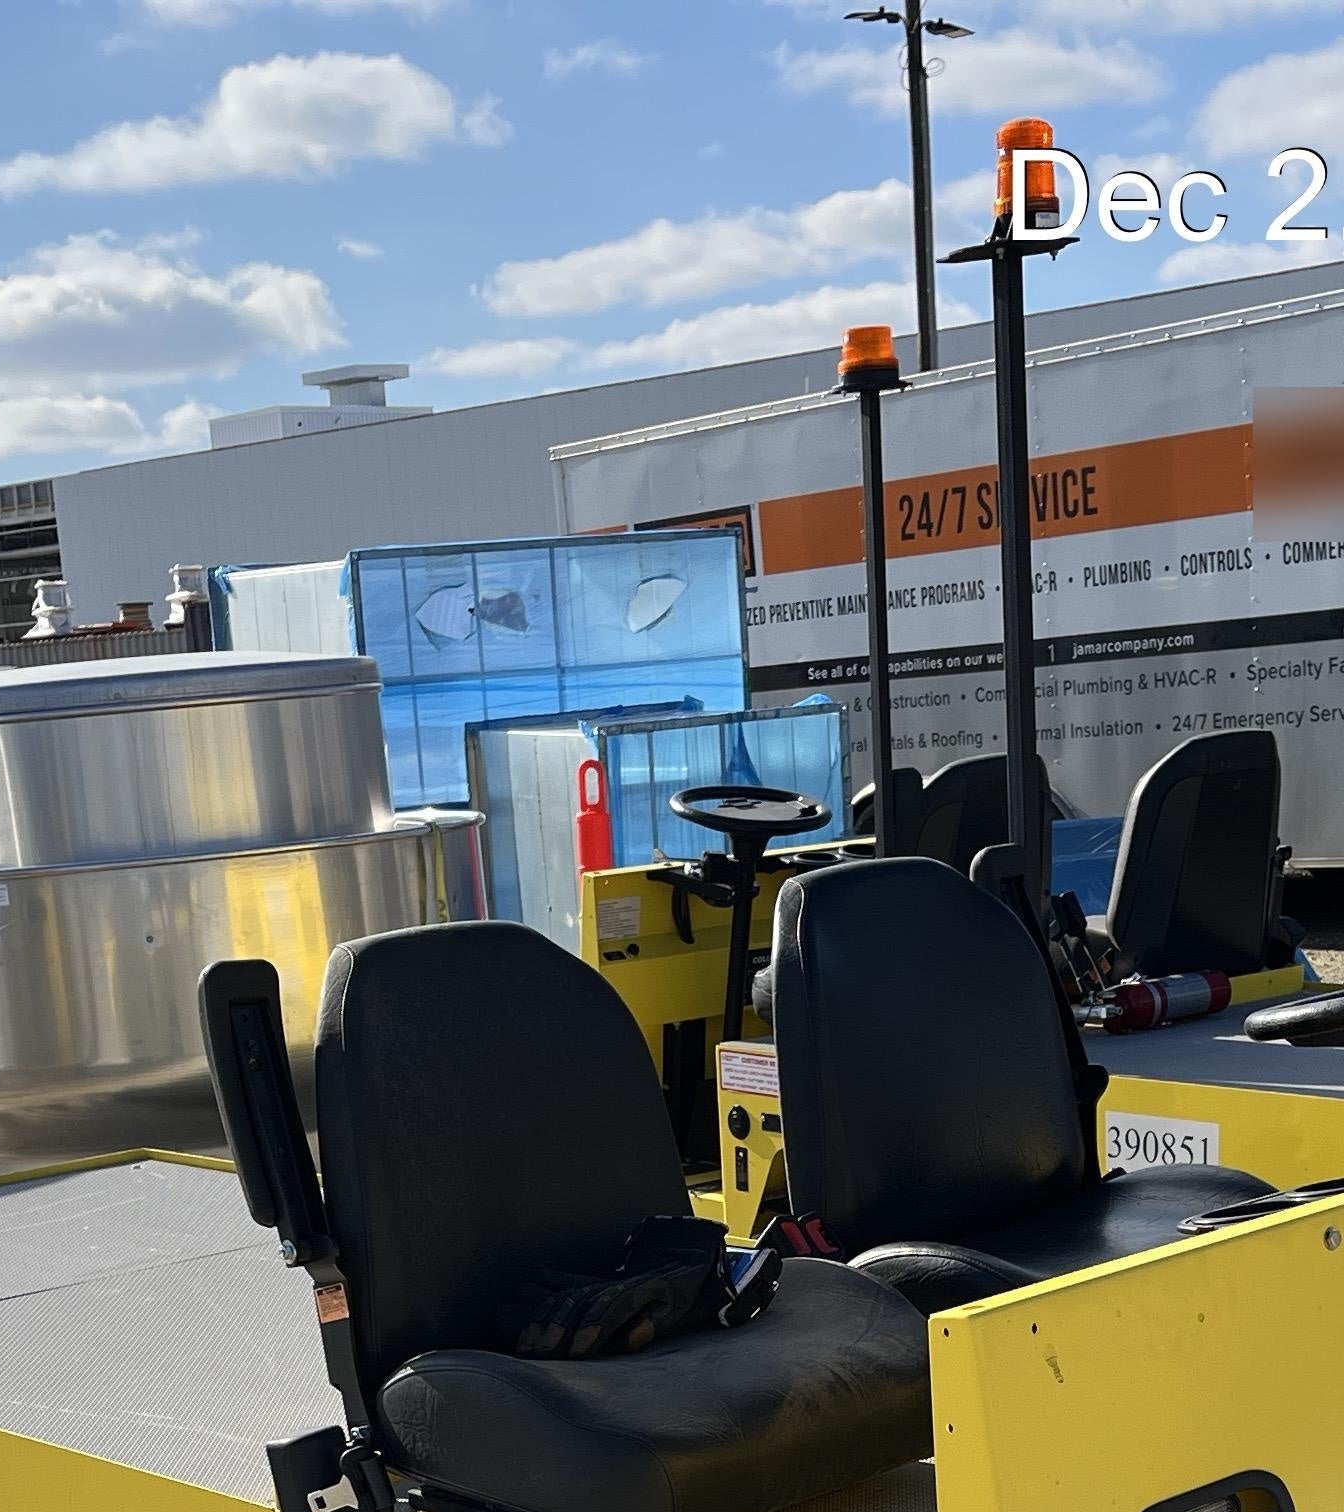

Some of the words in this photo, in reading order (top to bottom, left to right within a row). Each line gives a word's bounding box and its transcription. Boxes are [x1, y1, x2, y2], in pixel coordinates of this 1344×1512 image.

[899, 486, 966, 543] 24/7
[977, 466, 1098, 531] SVICE
[747, 606, 766, 627] ZED
[769, 597, 833, 624] PREVENTIVE
[837, 587, 917, 616] MAINANCE
[921, 579, 986, 607] PROGRAMS
[1084, 559, 1152, 588] PLUMBING
[1180, 548, 1253, 577] CONTROLS
[808, 667, 829, 681] See
[830, 665, 843, 679] all
[845, 663, 858, 677] of
[888, 657, 943, 676] apabilities
[946, 656, 961, 668] on
[964, 654, 983, 667] our
[986, 651, 1004, 665] we
[1071, 633, 1195, 660] jamarcompany.com
[853, 697, 863, 712] &
[975, 679, 1059, 704] Comcial
[1063, 676, 1133, 696] Plumbing
[1137, 673, 1149, 690] &
[1154, 667, 1217, 689] HVAC-R
[1246, 660, 1323, 684] Specialty
[891, 736, 914, 751] tals
[917, 735, 928, 748] &
[931, 730, 983, 748] Roofing
[1036, 723, 1066, 741] rmal
[1070, 720, 1144, 740] Insulation
[1172, 714, 1207, 732] 24/7
[1213, 709, 1305, 729] Emergency
[1107, 1126, 1208, 1165] 390851
